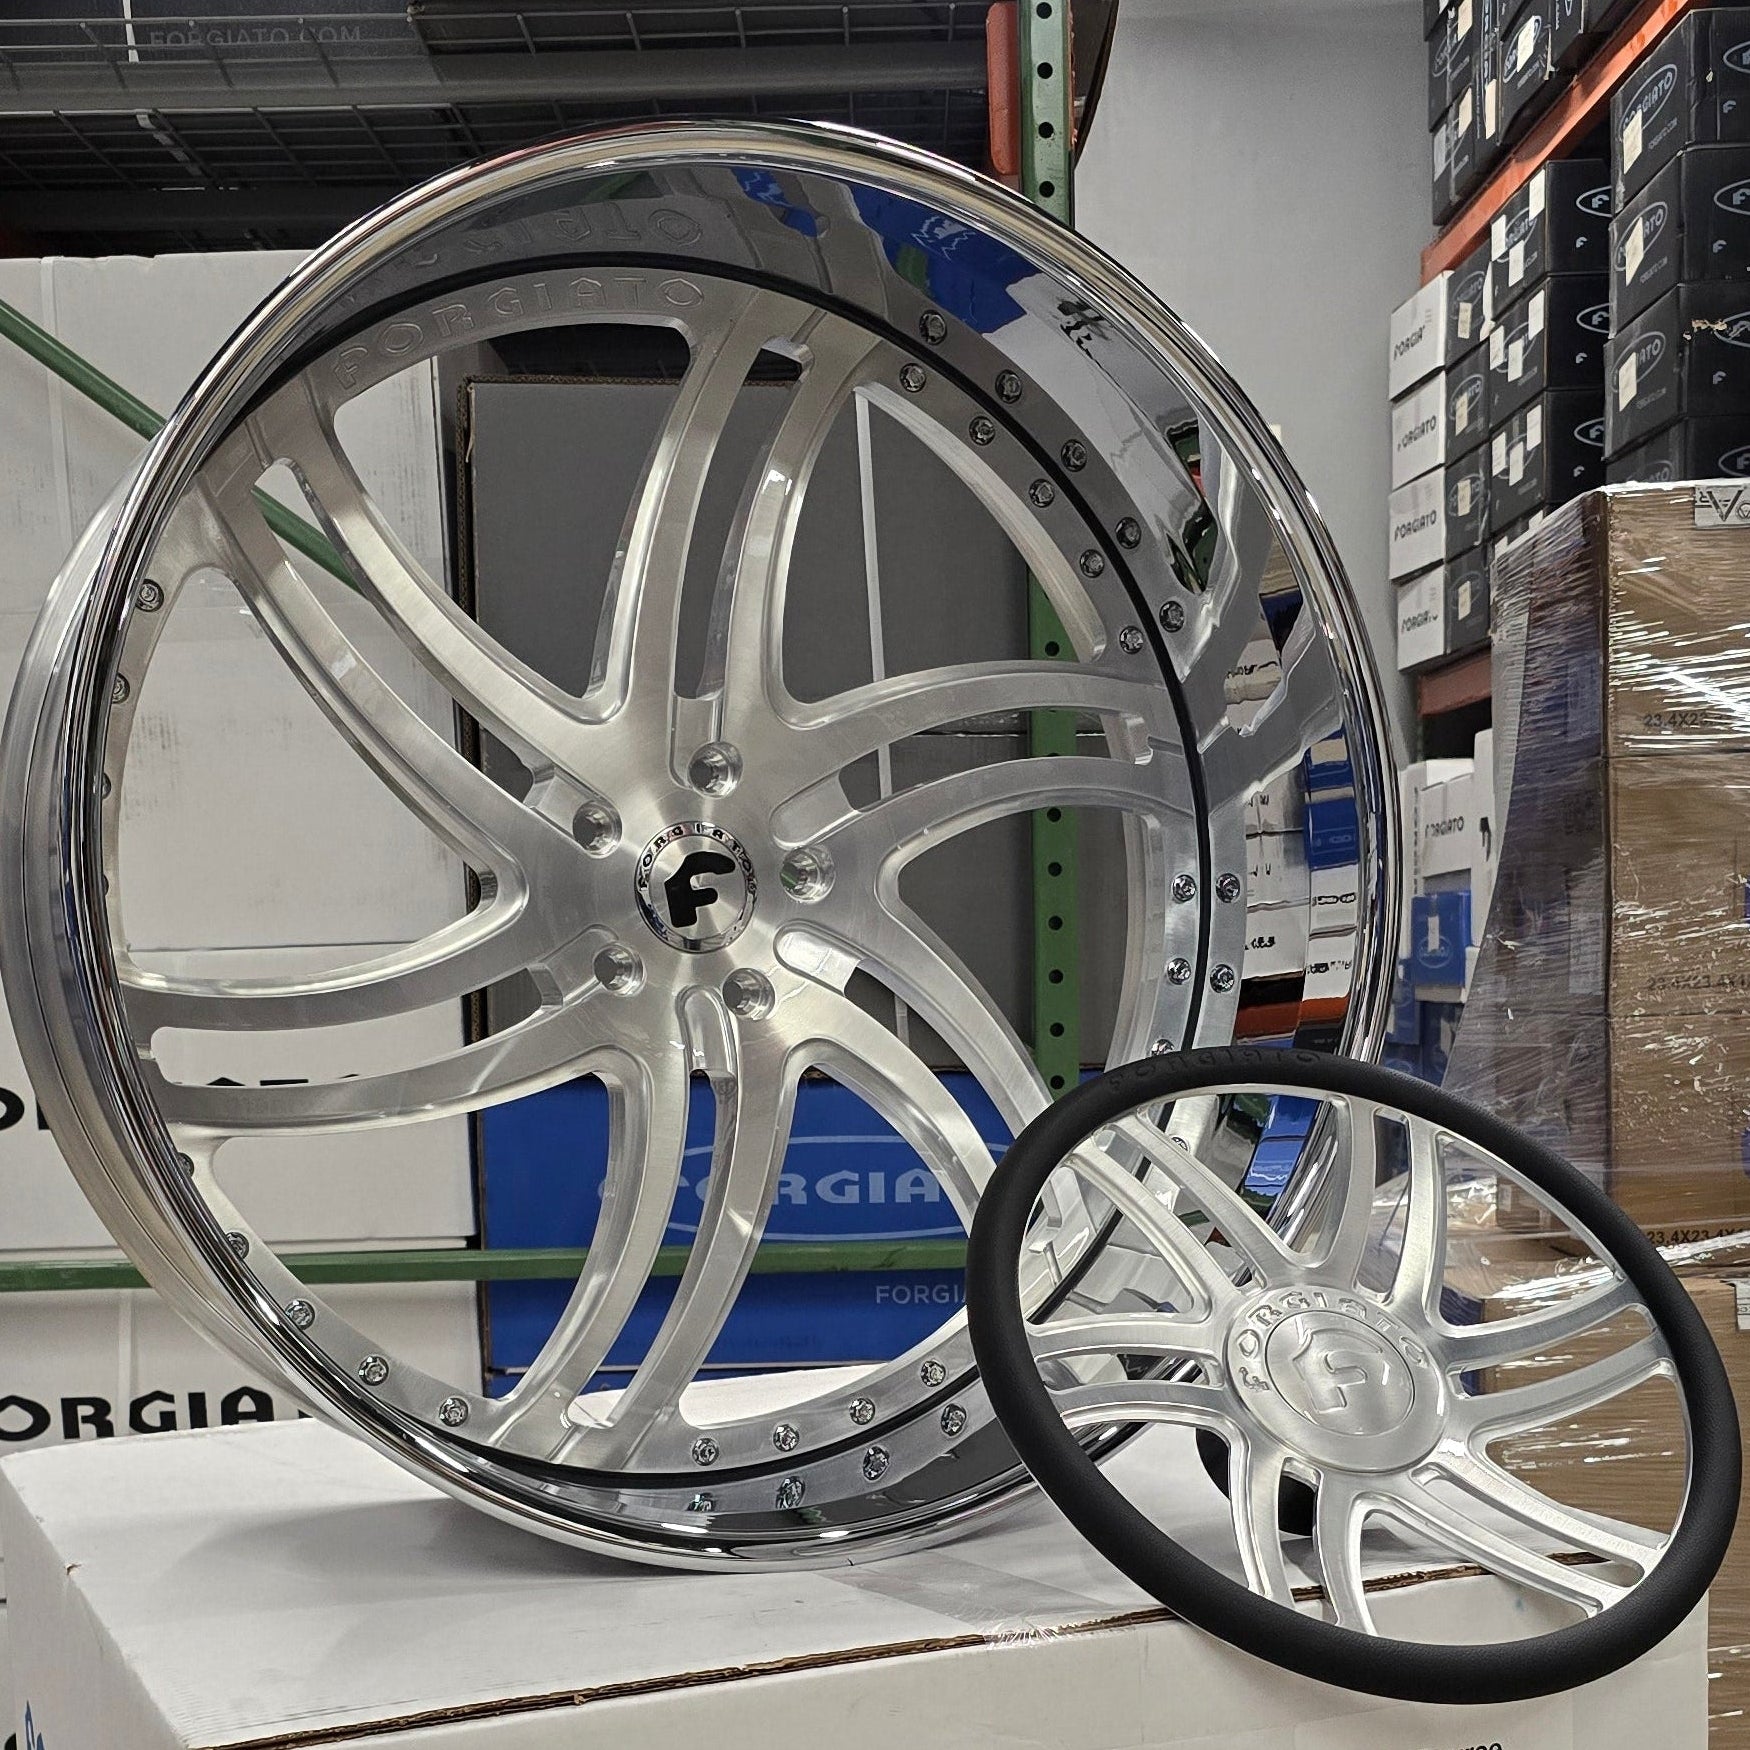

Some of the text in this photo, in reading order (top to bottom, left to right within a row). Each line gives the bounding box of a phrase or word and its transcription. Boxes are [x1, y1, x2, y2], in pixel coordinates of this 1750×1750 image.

[332, 276, 704, 390] FORGIATO
[664, 851, 736, 928] F
[1236, 1291, 1430, 1391] FORGIATO
